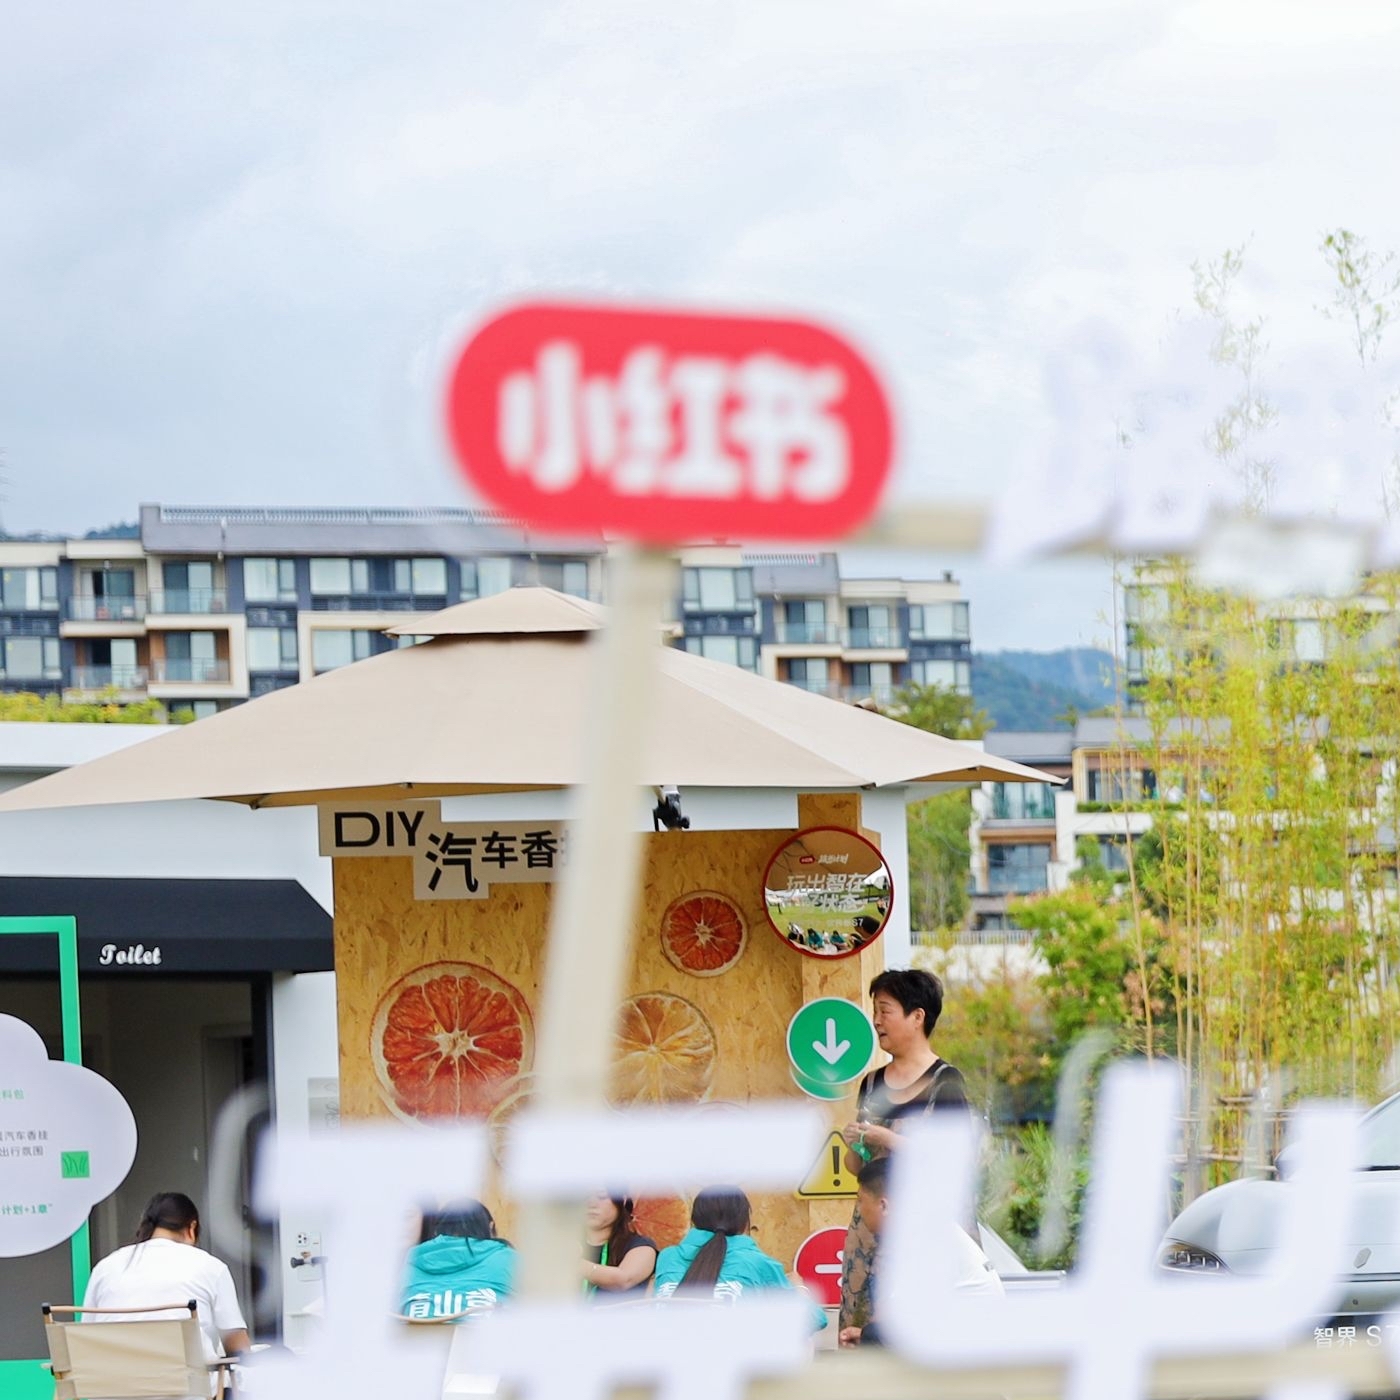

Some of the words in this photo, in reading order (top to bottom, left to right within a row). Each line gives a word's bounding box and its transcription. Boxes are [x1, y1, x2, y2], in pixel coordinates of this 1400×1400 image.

[497, 340, 851, 502] 小红书
[334, 811, 425, 848] DIY
[425, 830, 569, 893] 汽车香
[99, 943, 162, 965] Toilet
[1313, 1326, 1358, 1349] 智界
